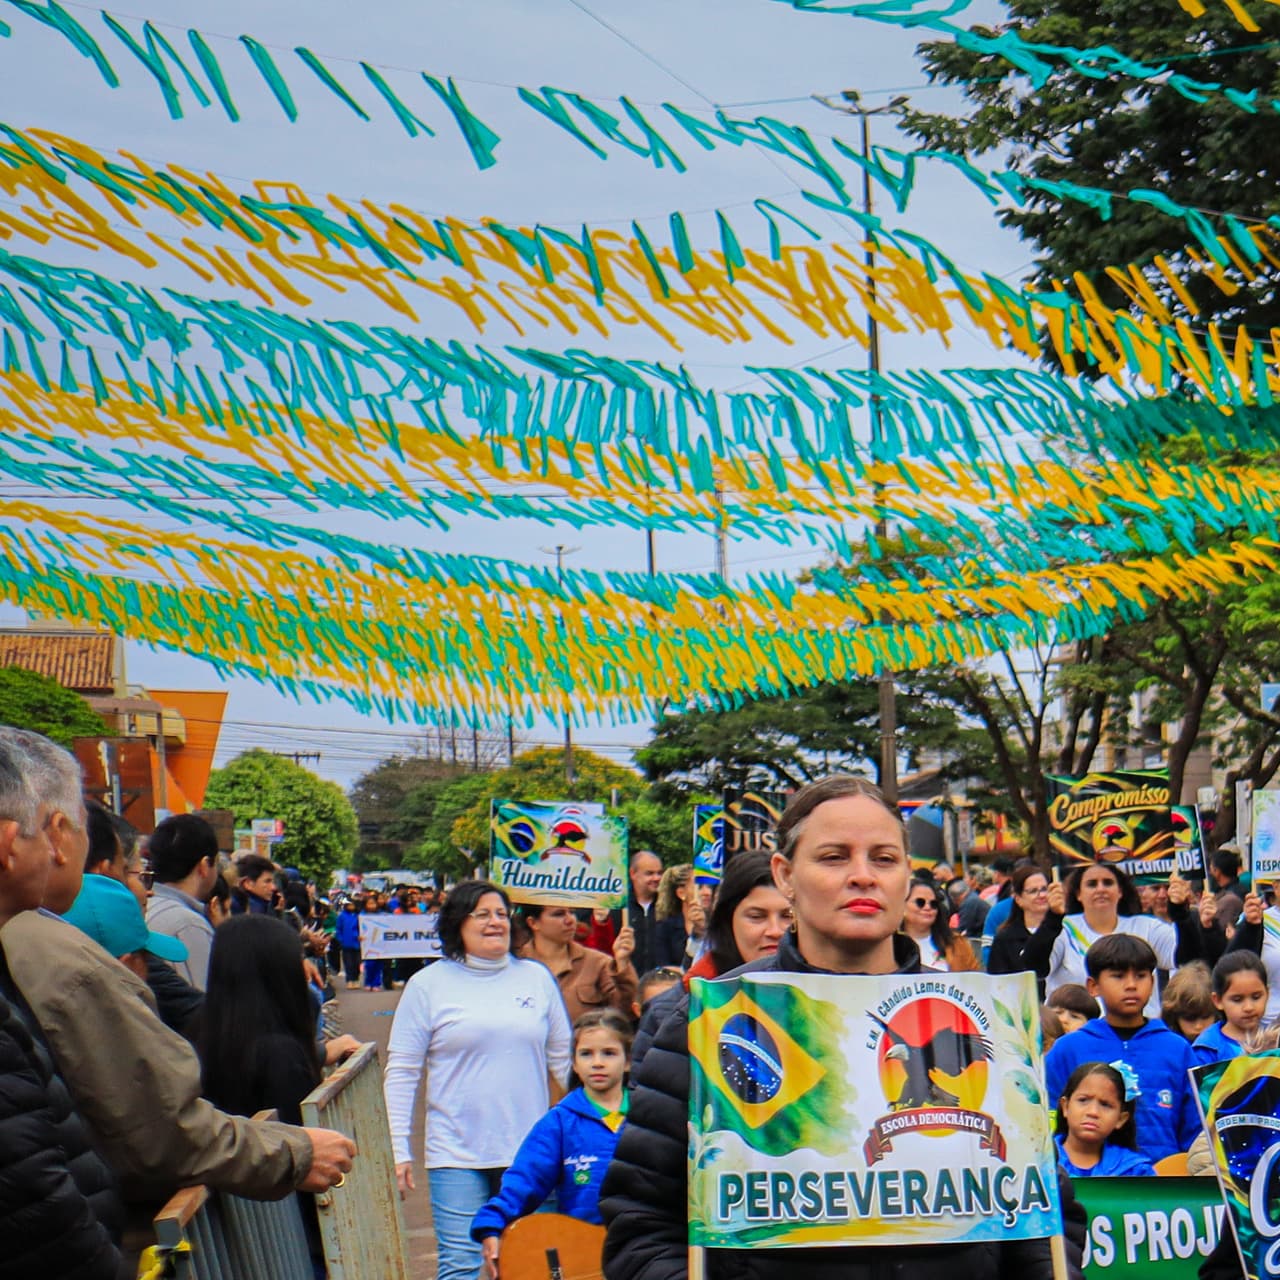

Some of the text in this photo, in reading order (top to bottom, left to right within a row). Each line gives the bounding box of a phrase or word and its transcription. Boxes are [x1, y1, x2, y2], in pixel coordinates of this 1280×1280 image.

[1048, 783, 1170, 830] Compromisso
[726, 830, 778, 851] JUS
[501, 860, 623, 894] Humildade
[1118, 848, 1202, 875] NTEGRIDADE
[383, 931, 408, 941] EM
[877, 986, 913, 1017] Cândido
[914, 982, 945, 994] Lemes
[948, 984, 965, 1002] dos
[965, 995, 990, 1031] Santos
[880, 1111, 987, 1135] ESCOLA DEMOCRÁTICA
[719, 1165, 1051, 1227] PERSEVERANÇA
[1081, 1215, 1115, 1268] S
